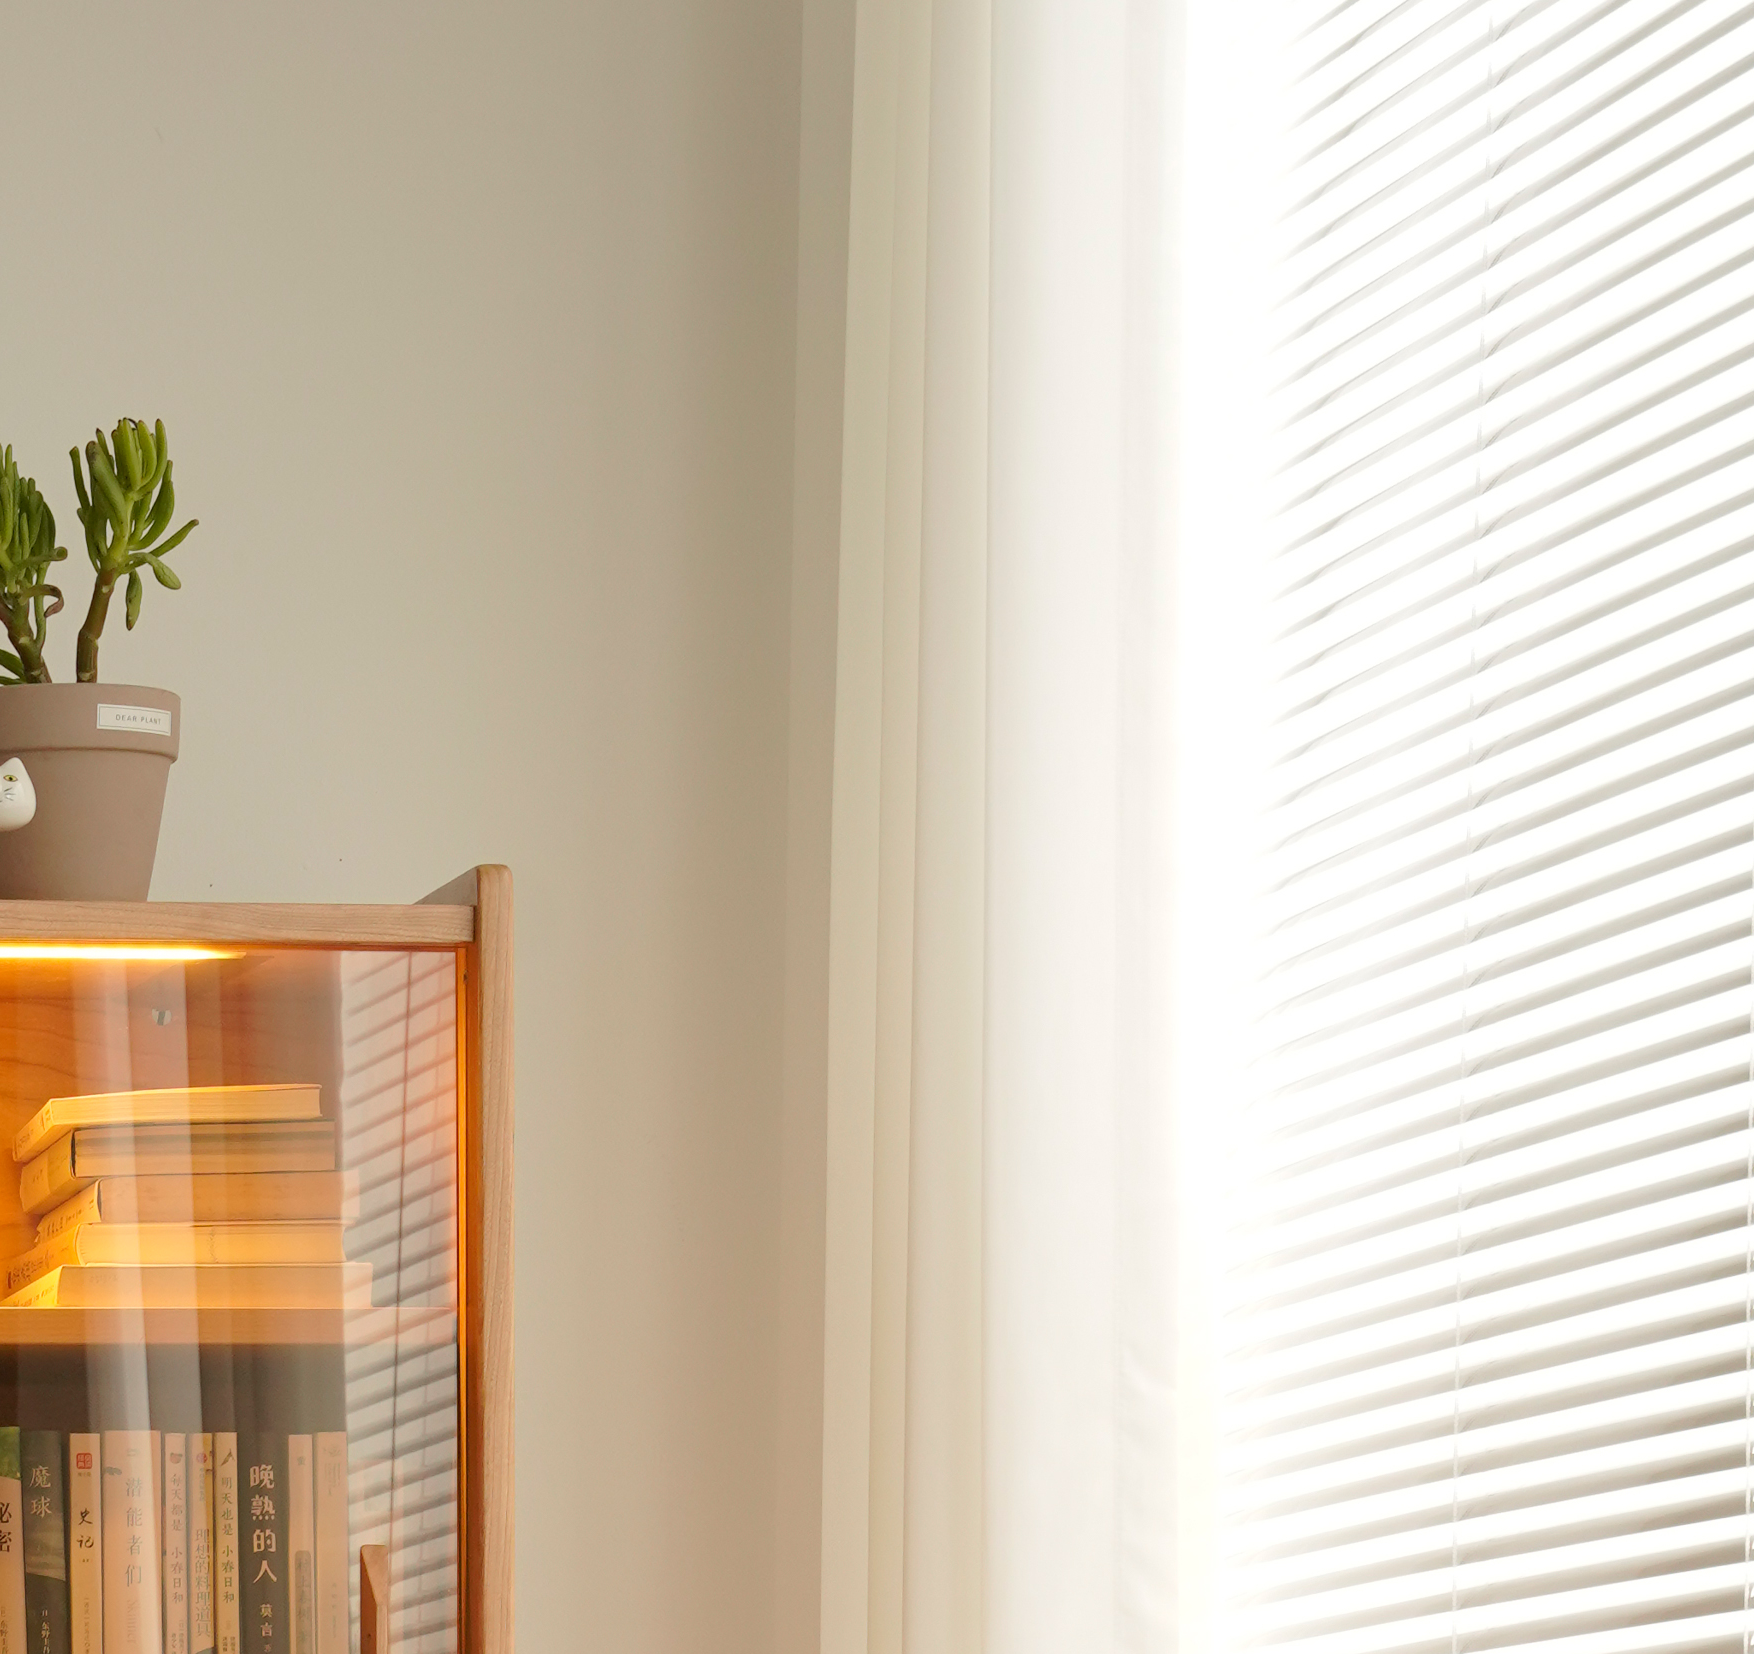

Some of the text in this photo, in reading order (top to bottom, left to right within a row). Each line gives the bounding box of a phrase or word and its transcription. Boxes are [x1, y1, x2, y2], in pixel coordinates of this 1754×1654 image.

[115, 713, 161, 725] DEAR PLANT
[29, 1465, 52, 1518] 魔球
[76, 1507, 95, 1550] 史记
[125, 1477, 143, 1588] 潜能者们
[221, 1476, 235, 1604] 明天也是 小春日和
[249, 1464, 278, 1584] 晚熟的人
[171, 1546, 184, 1604] 小春日和
[195, 1528, 211, 1638] 理想的料理道具
[260, 1603, 273, 1637] 莫言
